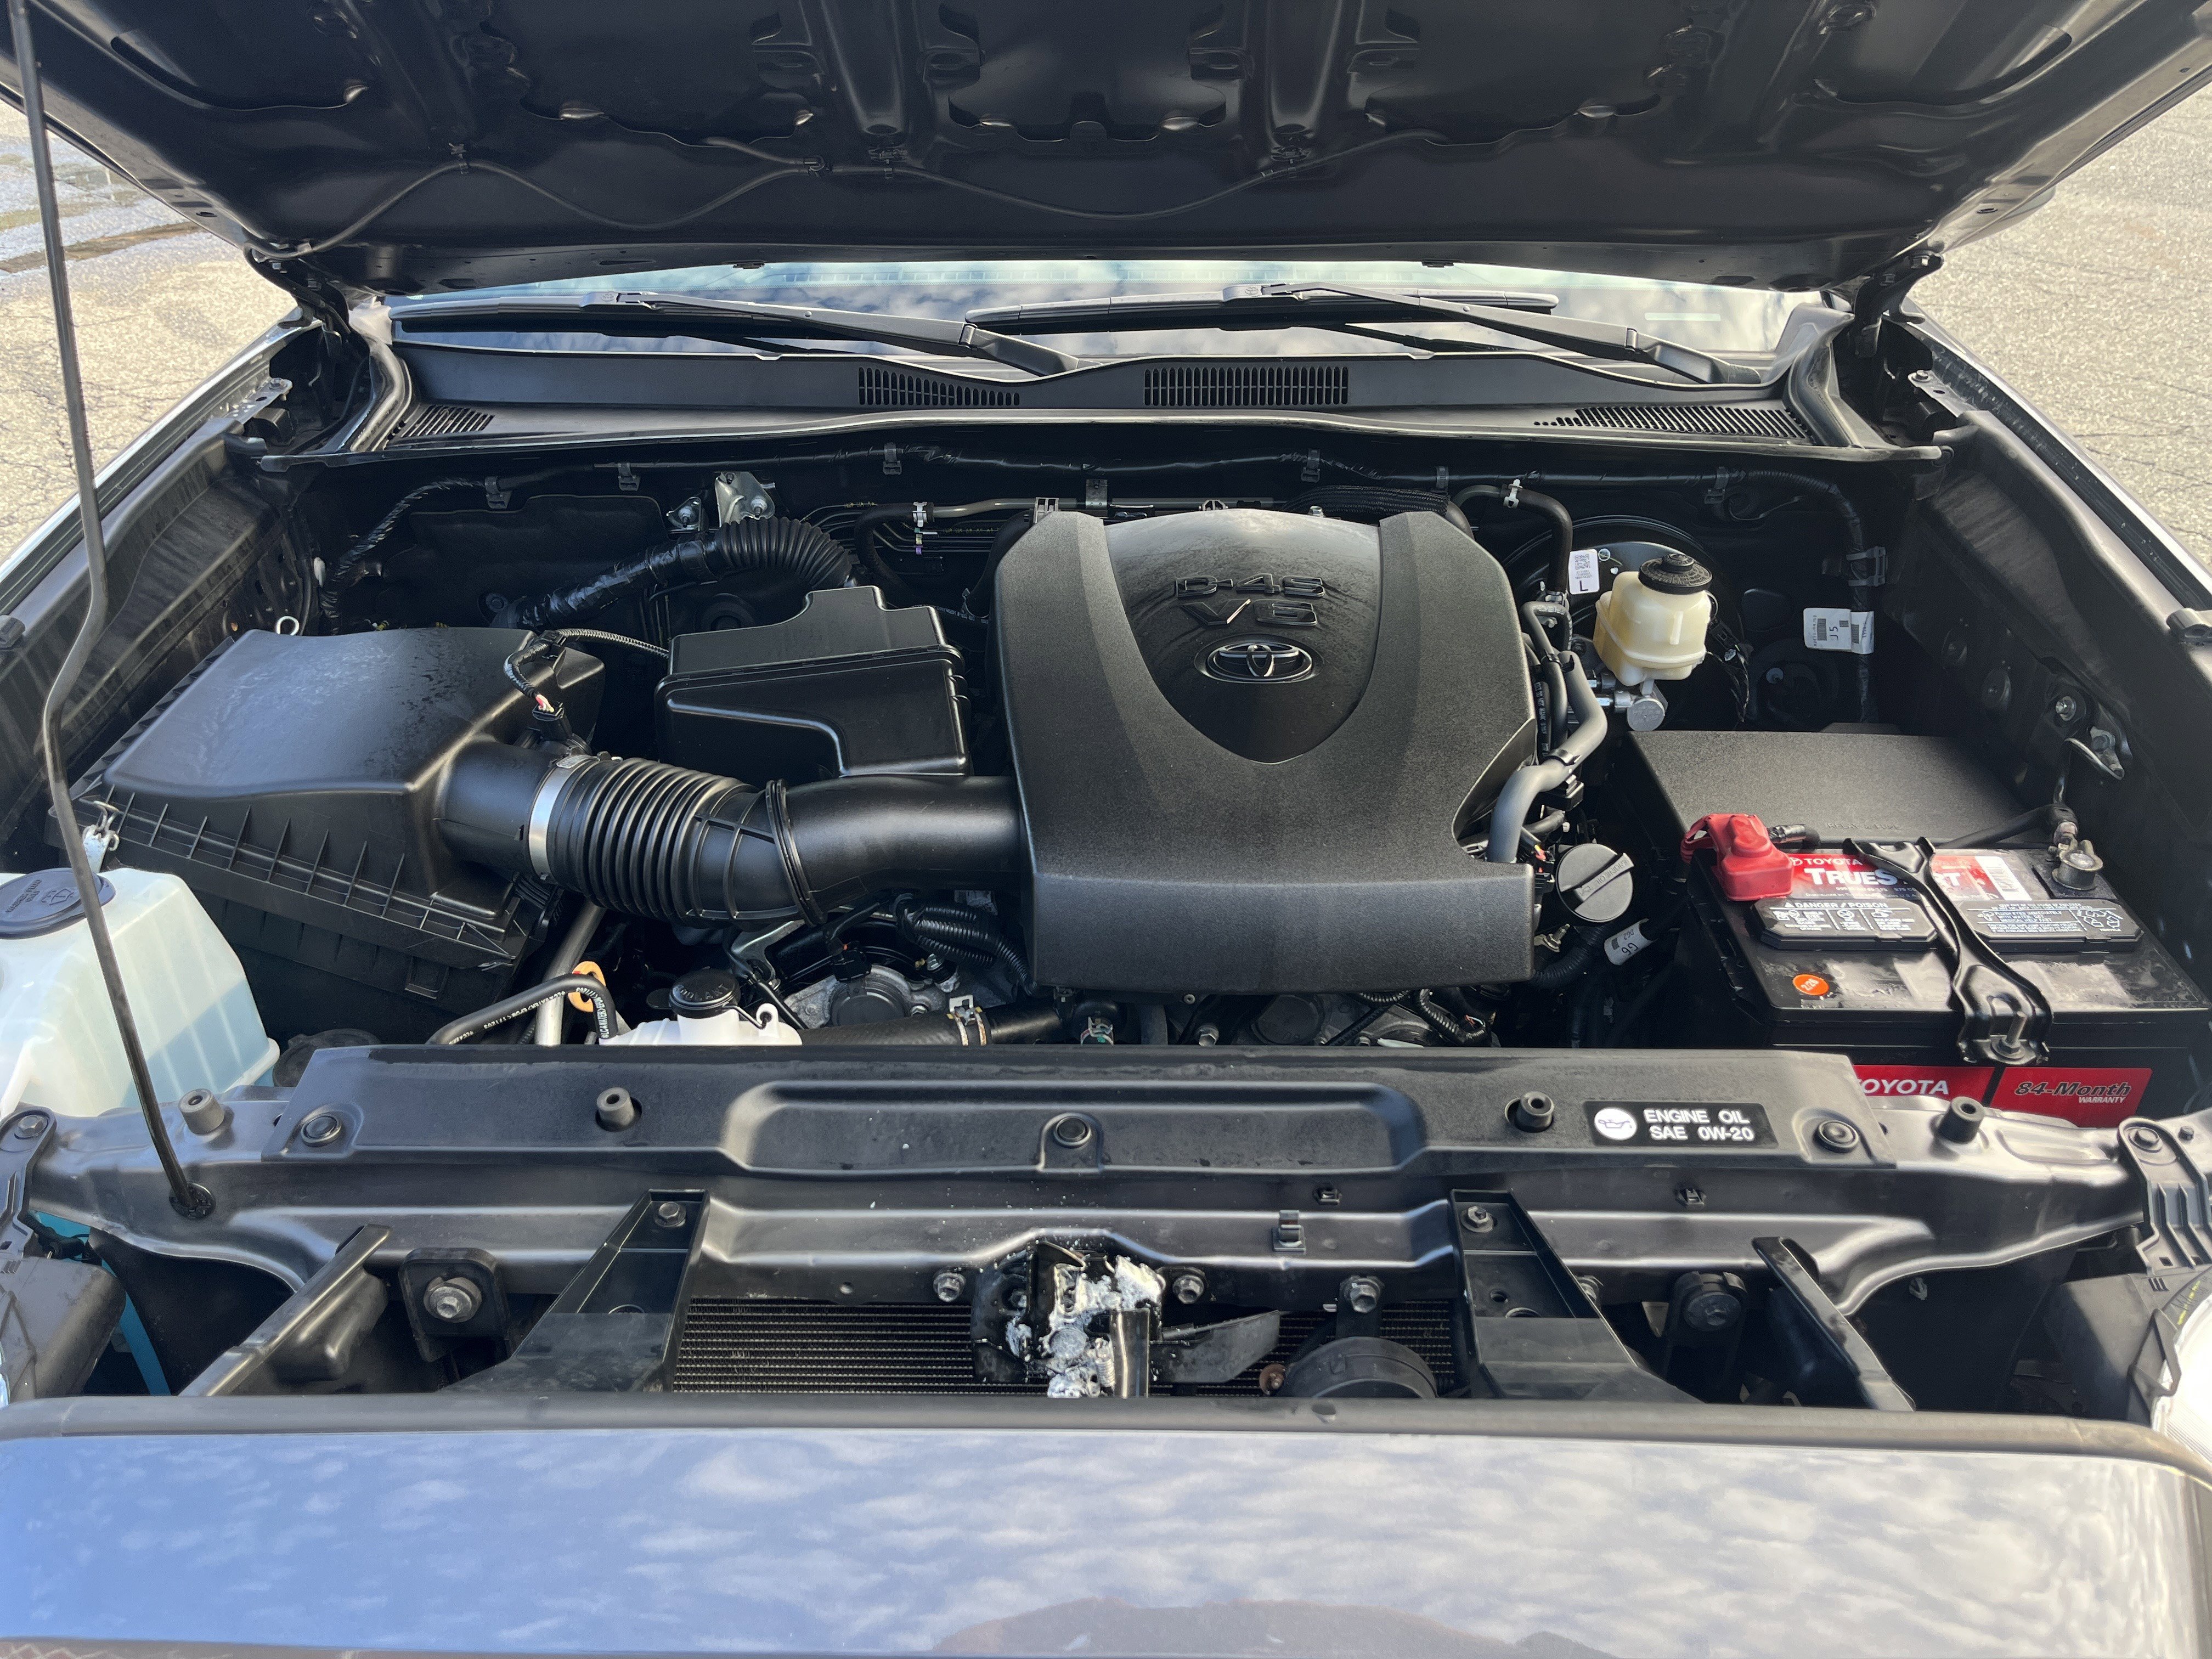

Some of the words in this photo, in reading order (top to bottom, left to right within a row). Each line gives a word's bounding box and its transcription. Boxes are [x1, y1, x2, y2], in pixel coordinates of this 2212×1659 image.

[1175, 573, 1326, 599] D-4S
[1579, 580, 1588, 591] L
[1180, 599, 1318, 626] V6
[1804, 857, 1863, 866] TOYOTA
[1857, 1079, 1949, 1095] OYOTA
[2014, 1081, 2132, 1097] 84-Month
[1643, 1108, 1710, 1124] ENGINE
[1718, 1109, 1750, 1124] OIL
[1649, 1126, 1688, 1141] SAE
[1697, 1126, 1755, 1142] 0W-20
